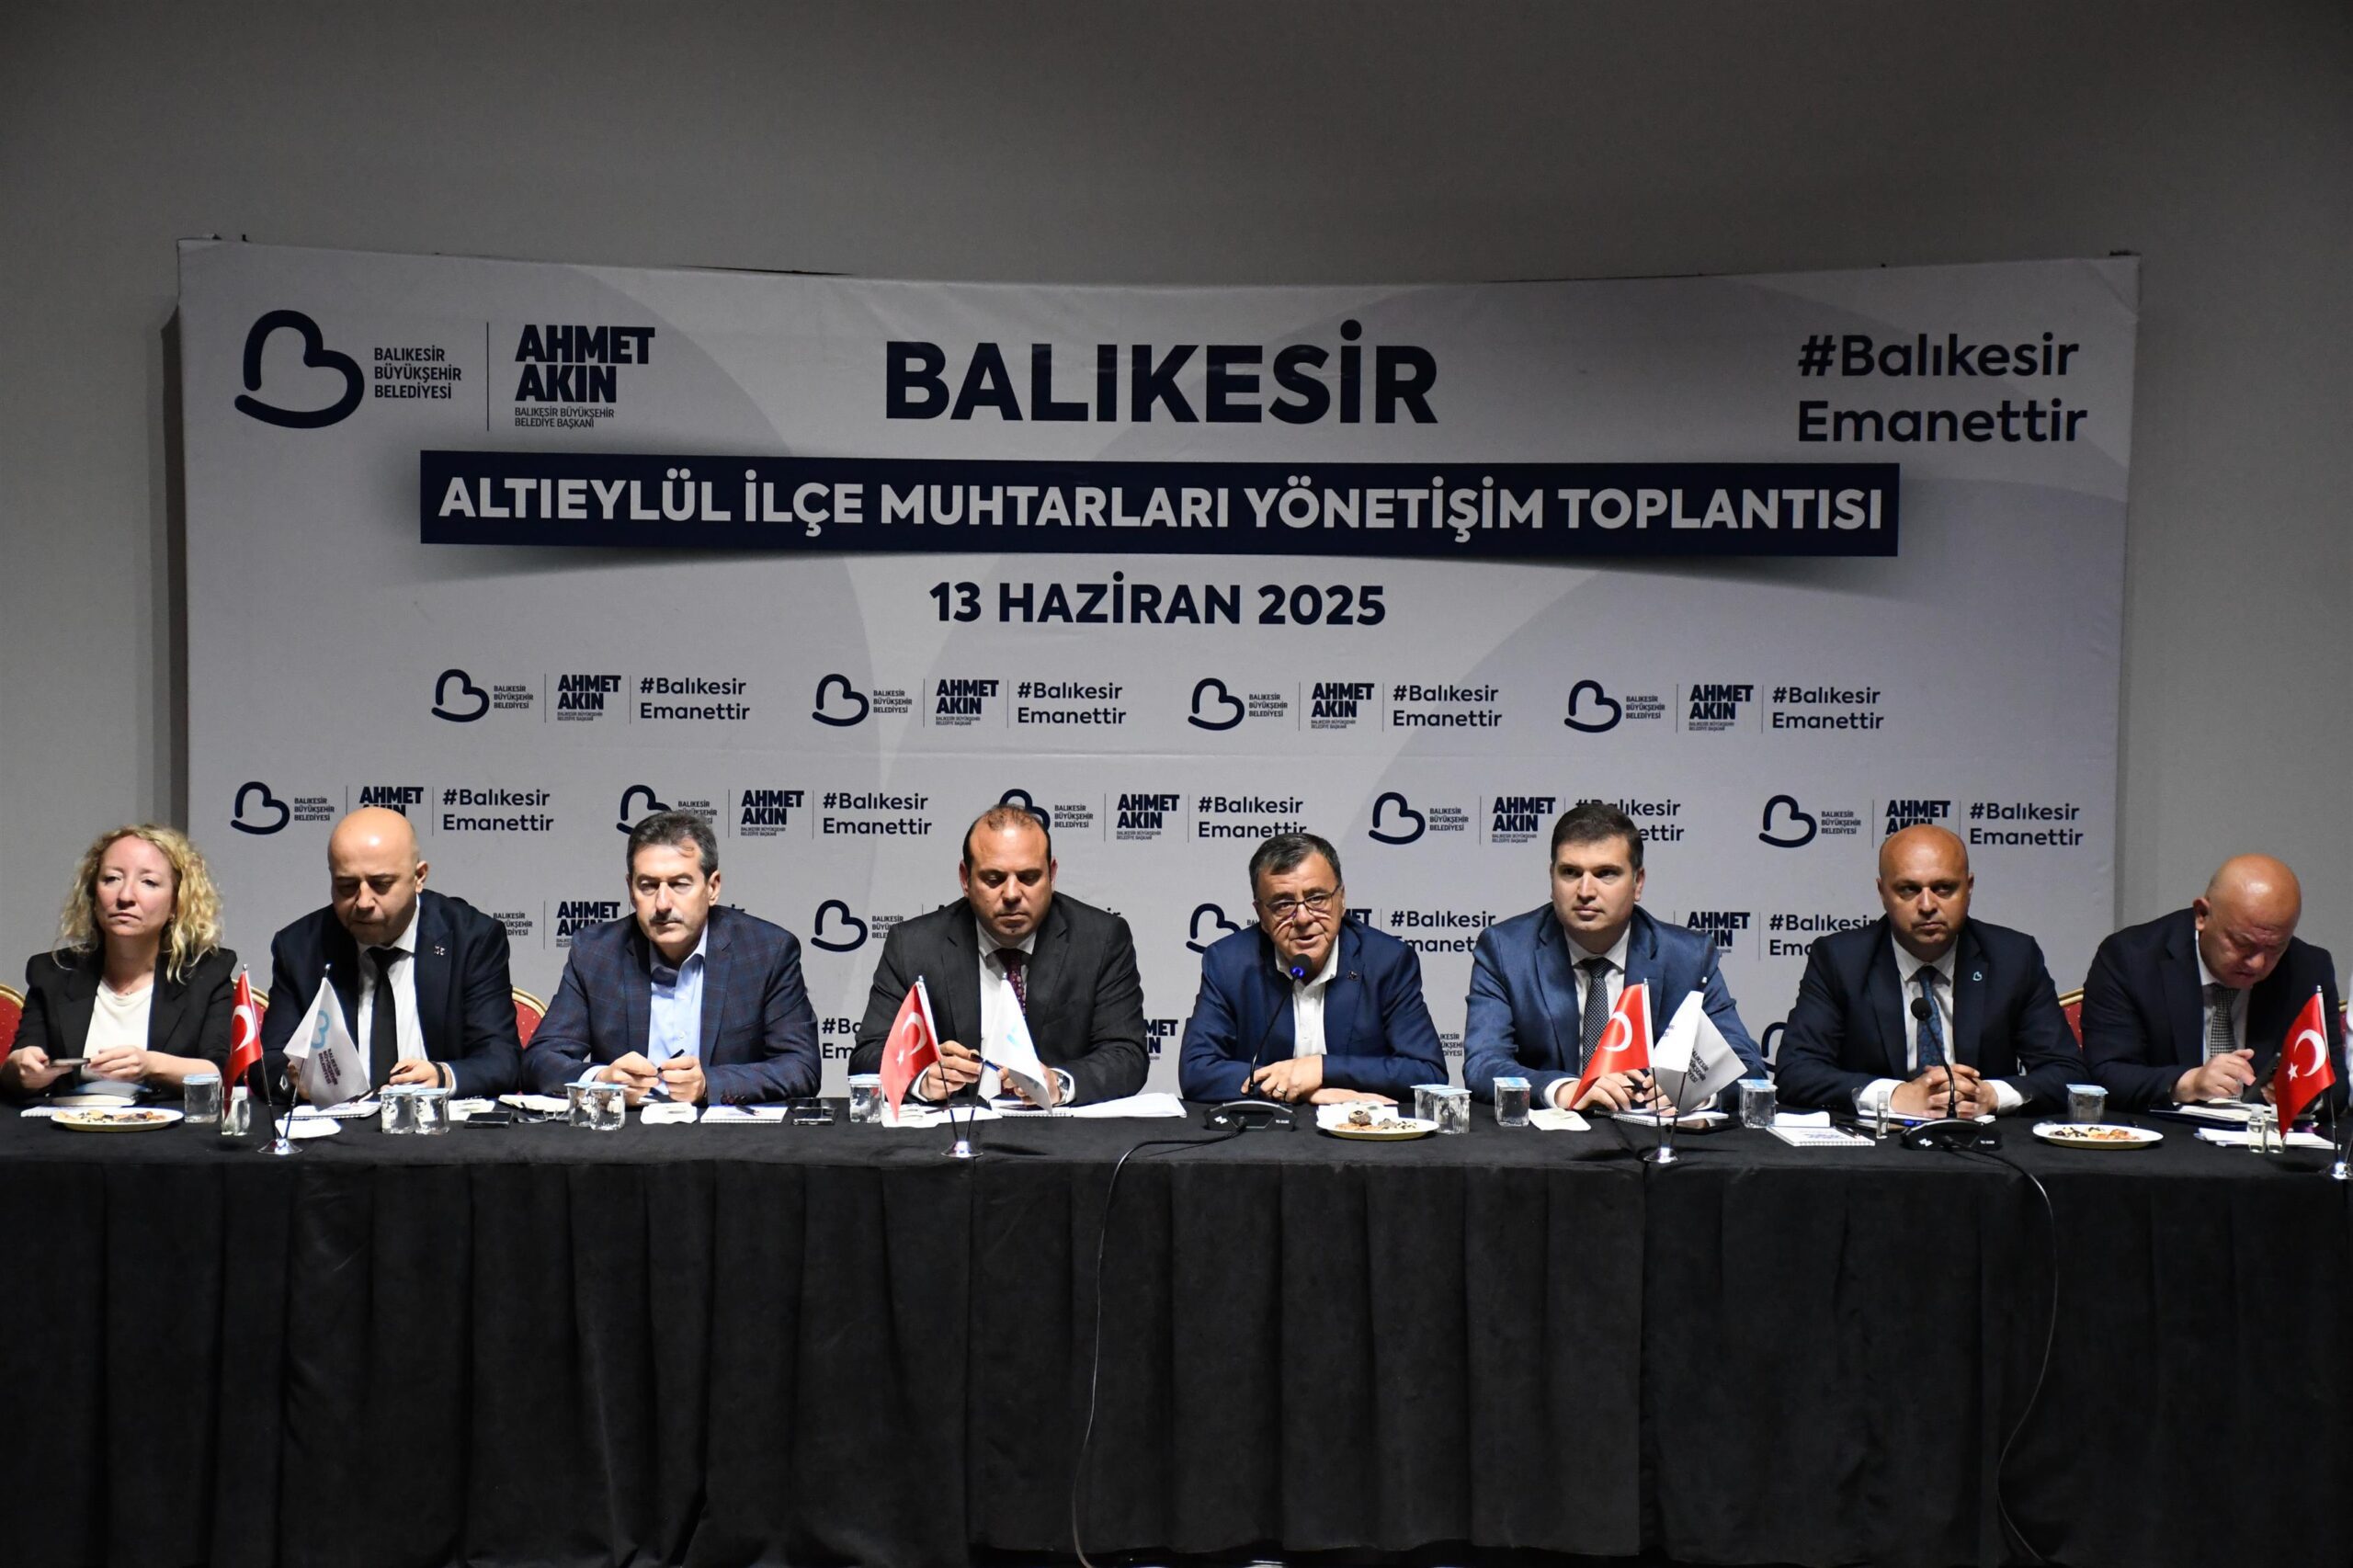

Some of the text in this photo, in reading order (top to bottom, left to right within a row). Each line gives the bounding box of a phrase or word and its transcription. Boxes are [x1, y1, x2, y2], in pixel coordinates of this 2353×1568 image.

[515, 324, 655, 364] AHMET
[374, 345, 446, 362] BALIKESİR
[1798, 332, 2079, 377] #Balıkesir
[374, 362, 461, 383] BÜYÜKŞEHİR
[886, 319, 1438, 425] BALIKESİR
[374, 381, 451, 400] BELEDİYESİ
[515, 364, 617, 403] AKIN
[515, 404, 614, 418] BALIKESİR BÜYÜKŞEHİR
[515, 416, 555, 427] BELEDİYE
[1799, 398, 2087, 442] Emanettir
[438, 469, 1881, 542] ALTIEYLÜL İLÇE MUHTARLARI YÖNETİŞİM TOPLANTISI
[930, 571, 1385, 625] 13 HAZİRAN 2025
[494, 684, 526, 692] BALIKESİR
[558, 675, 621, 692] AHMET
[641, 677, 746, 695] #Balıkesir
[937, 679, 999, 697] AHMET
[1017, 682, 1122, 699] #Balıkesir
[1312, 683, 1374, 699] AHMET
[558, 692, 603, 710] AKIN
[873, 688, 905, 697] BALIKESİR
[1249, 693, 1281, 701] BALIKESİR
[1393, 685, 1498, 701] #Balıkesir
[1626, 695, 1658, 703] BALIKESİR
[1690, 685, 1754, 701] AHMET
[1773, 687, 1881, 703] #Balıkesir
[641, 703, 750, 720] Emanettir
[937, 698, 982, 714] AKIN
[1312, 700, 1357, 717] AKIN
[1689, 702, 1735, 720] AKIN
[1018, 707, 1126, 723] Emanettir
[1393, 710, 1502, 726] Emanettir
[1773, 712, 1883, 729] Emanettir
[294, 797, 326, 805] BALIKESİR
[359, 787, 424, 803] AHMET
[443, 789, 550, 805] #Balıkesir
[678, 799, 710, 808] BALIKESİR
[742, 790, 804, 807] AHMET
[824, 793, 928, 810] #Balıkesir
[1118, 794, 1179, 811] AHMET
[1054, 804, 1086, 812] BALIKESİR
[1199, 797, 1303, 813] #Balıkesir
[1429, 807, 1461, 815] BALIKESİR
[1493, 797, 1555, 813] AHMET
[1886, 801, 1950, 817] AHMET
[1970, 803, 2079, 820] #Balıkesir
[444, 814, 553, 831] Emanettir
[741, 808, 787, 824] AKIN
[1117, 812, 1162, 828] AKIN
[1493, 814, 1538, 831] AKIN
[1821, 811, 1853, 819] BALIKESİR
[824, 818, 932, 835] Emanettir
[1639, 824, 1684, 841] ettir
[1971, 828, 2083, 846] Emanettir
[493, 911, 526, 919] BALIKESİR
[557, 902, 620, 918] AHMET
[1688, 912, 1750, 929] AHMET
[1145, 1019, 1178, 1036] MET
